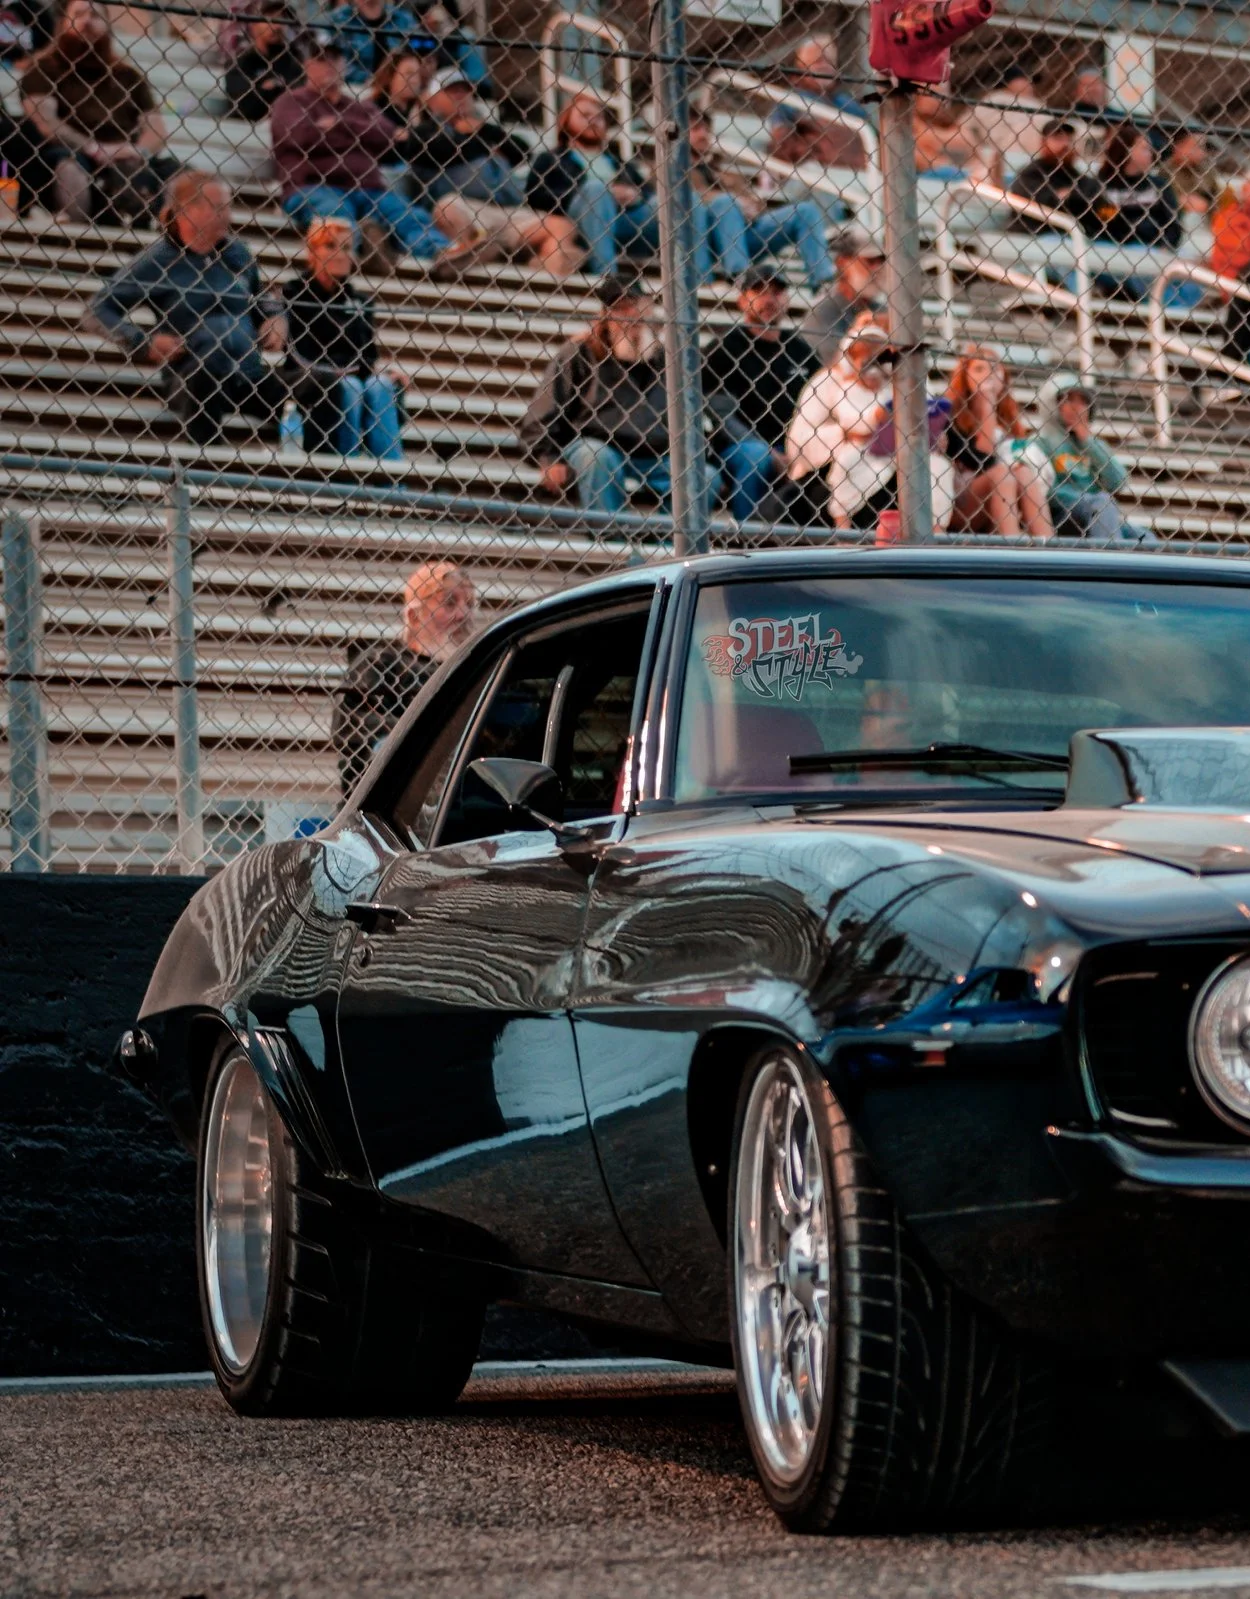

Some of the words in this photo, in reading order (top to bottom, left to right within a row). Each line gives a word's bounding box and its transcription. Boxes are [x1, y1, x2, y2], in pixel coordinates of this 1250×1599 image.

[727, 612, 836, 659] STEEL
[731, 653, 749, 676] &
[751, 643, 847, 702] STYLE
